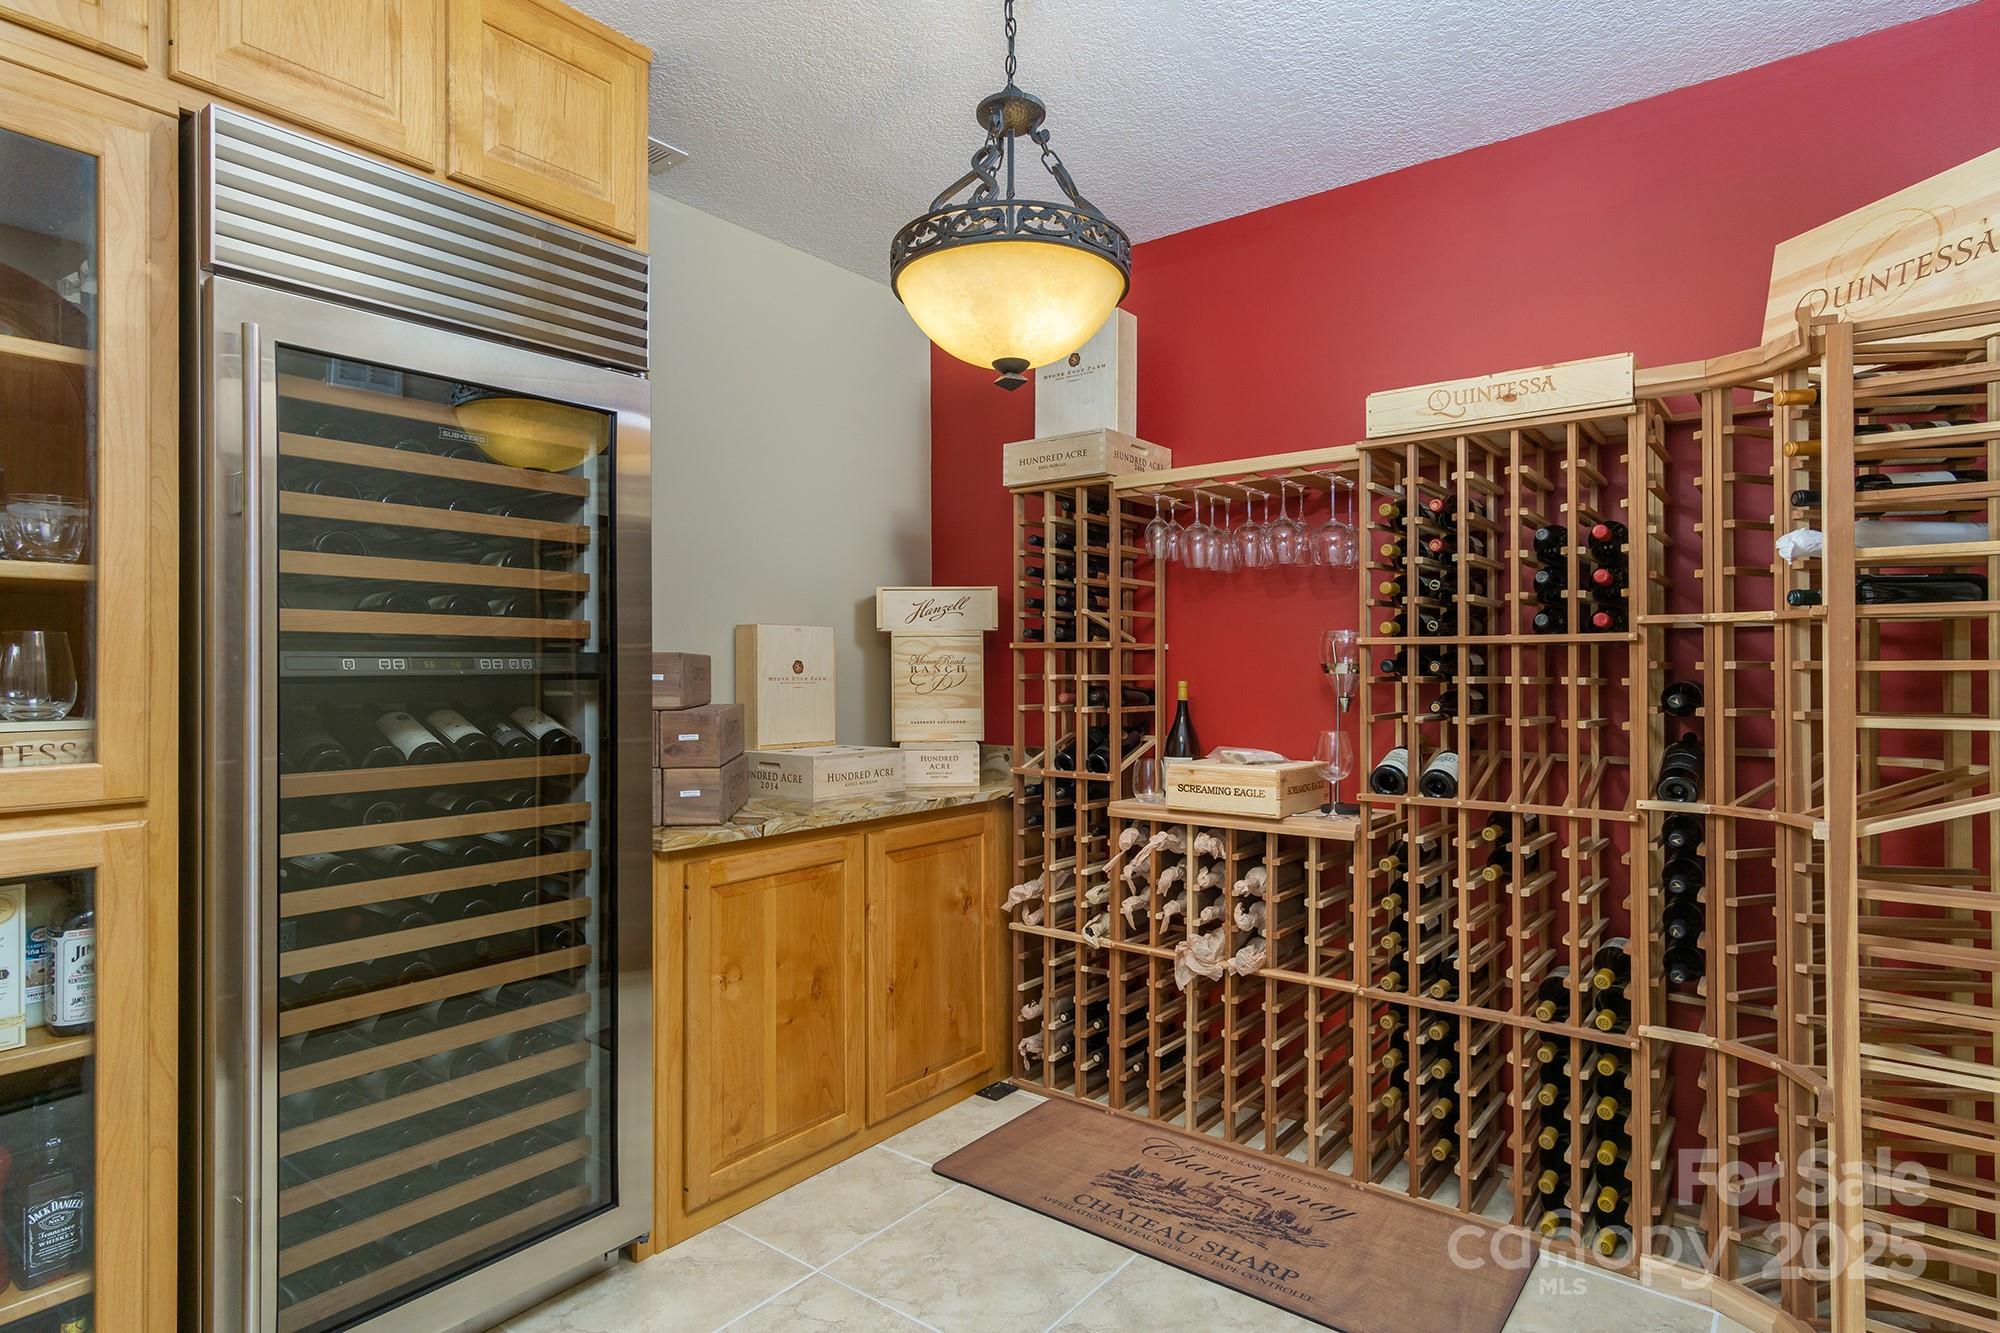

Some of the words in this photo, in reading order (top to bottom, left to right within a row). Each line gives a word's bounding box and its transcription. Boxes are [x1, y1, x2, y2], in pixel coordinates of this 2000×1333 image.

[1794, 226, 2000, 324] QUINTESSA
[1427, 375, 1557, 418] QUINTESSA
[1019, 452, 1064, 466] HUNDRED
[1064, 448, 1088, 460] ACRE
[1113, 450, 1148, 467] HUNDRED
[904, 596, 971, 624] Hanzell
[910, 665, 966, 673] RANCH
[780, 773, 803, 784] ACRE
[827, 772, 871, 783] HUNDRED
[873, 767, 895, 778] ACRE
[760, 781, 779, 790] 2014
[1177, 783, 1232, 796] SCREAMING
[1233, 787, 1266, 799] EAGLE
[1231, 1157, 1267, 1174] GRAND
[1142, 1137, 1358, 1222] Chardonnay
[27, 1206, 52, 1225] JACK
[1041, 1195, 1105, 1223] APPELLATION
[38, 1231, 76, 1248] WHISKEY
[1073, 1193, 1199, 1245] CHATEAU
[1200, 1240, 1301, 1282] SHARP
